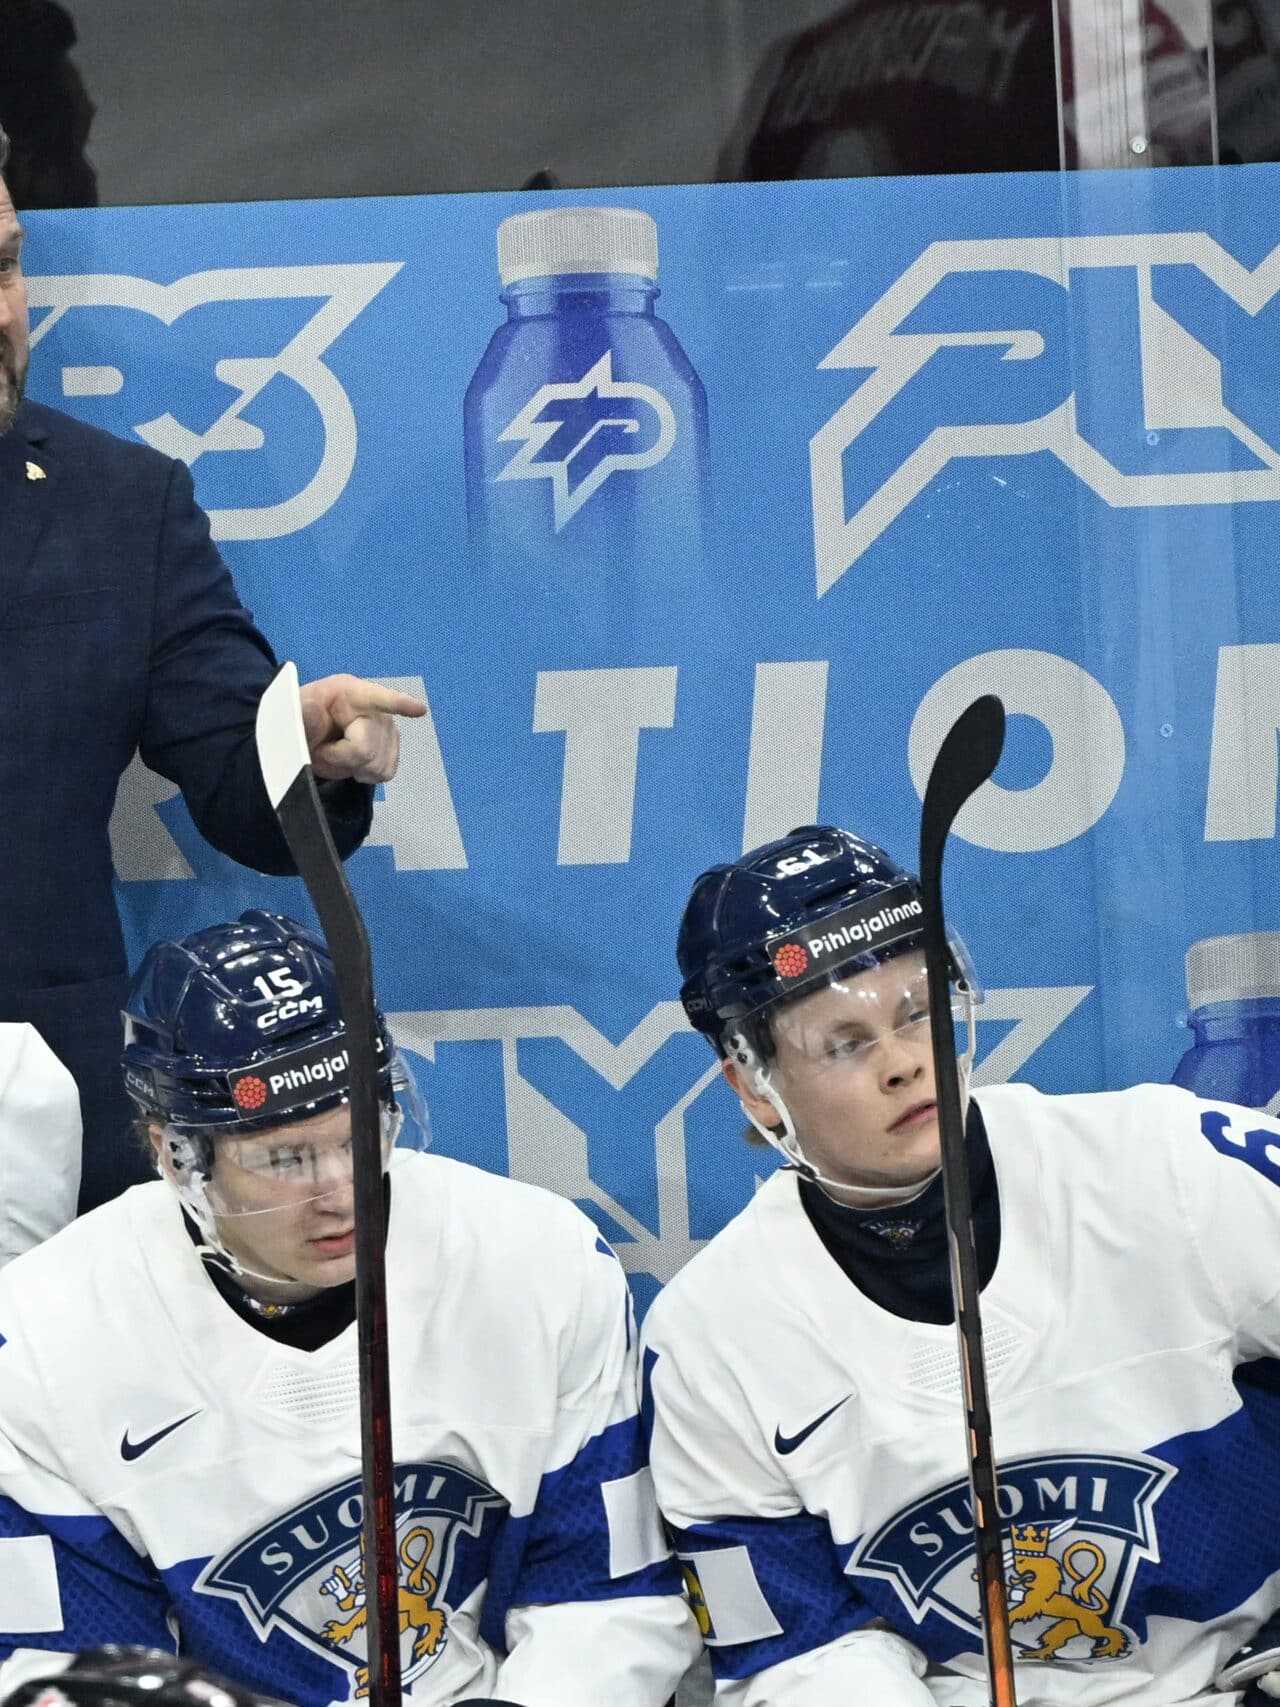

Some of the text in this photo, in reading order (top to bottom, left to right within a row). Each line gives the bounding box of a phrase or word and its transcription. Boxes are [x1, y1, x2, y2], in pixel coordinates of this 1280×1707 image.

[808, 900, 922, 958] Pihlajalinna
[253, 967, 304, 1000] 15
[257, 996, 323, 1029] CCM
[126, 1072, 154, 1097] CCM
